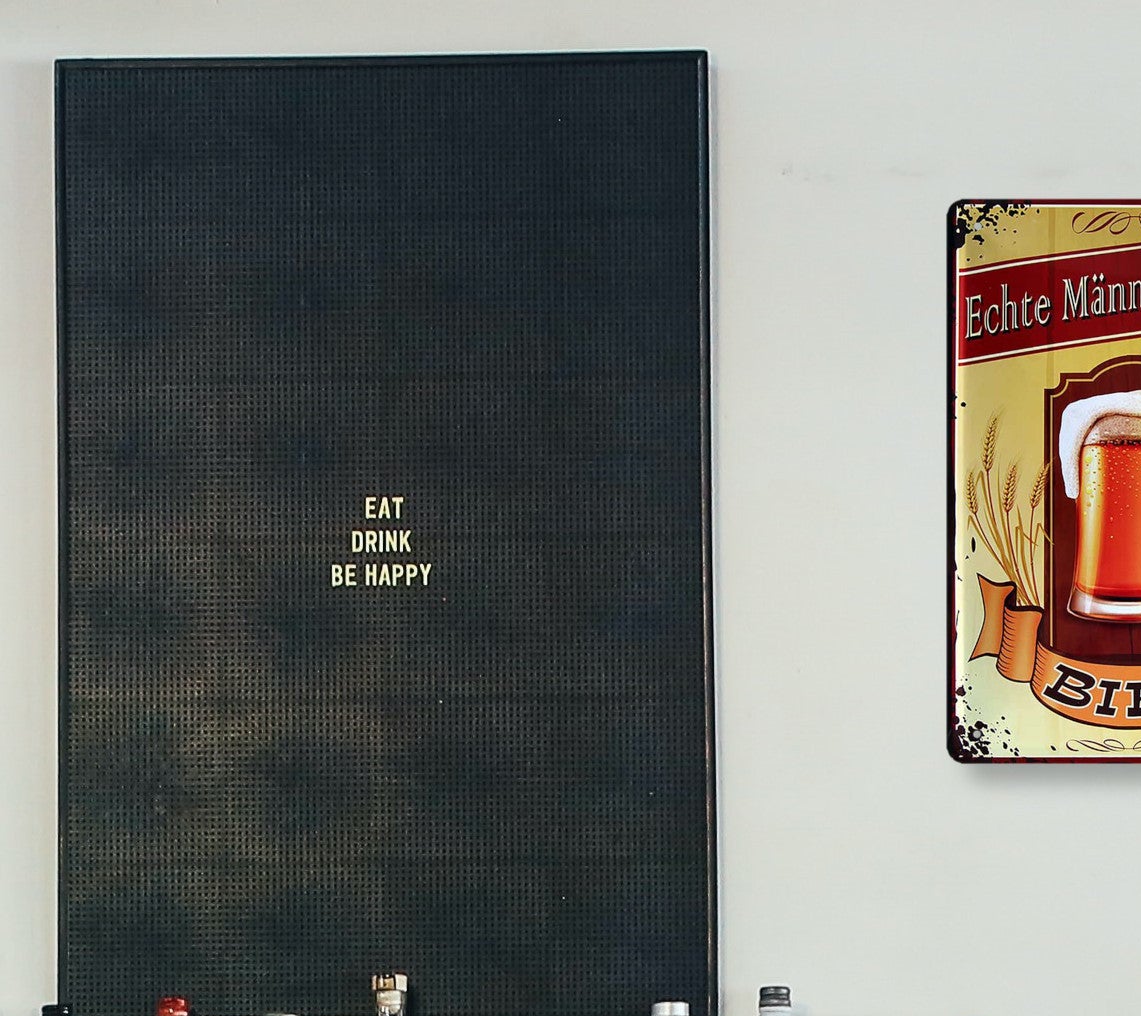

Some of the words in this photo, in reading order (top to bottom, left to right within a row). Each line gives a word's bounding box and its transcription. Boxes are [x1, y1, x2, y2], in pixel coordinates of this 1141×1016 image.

[964, 281, 1052, 341] Echte
[365, 496, 404, 519] EAT
[351, 529, 412, 553] DRINK
[331, 563, 357, 587] BE
[365, 563, 432, 586] HAPPY
